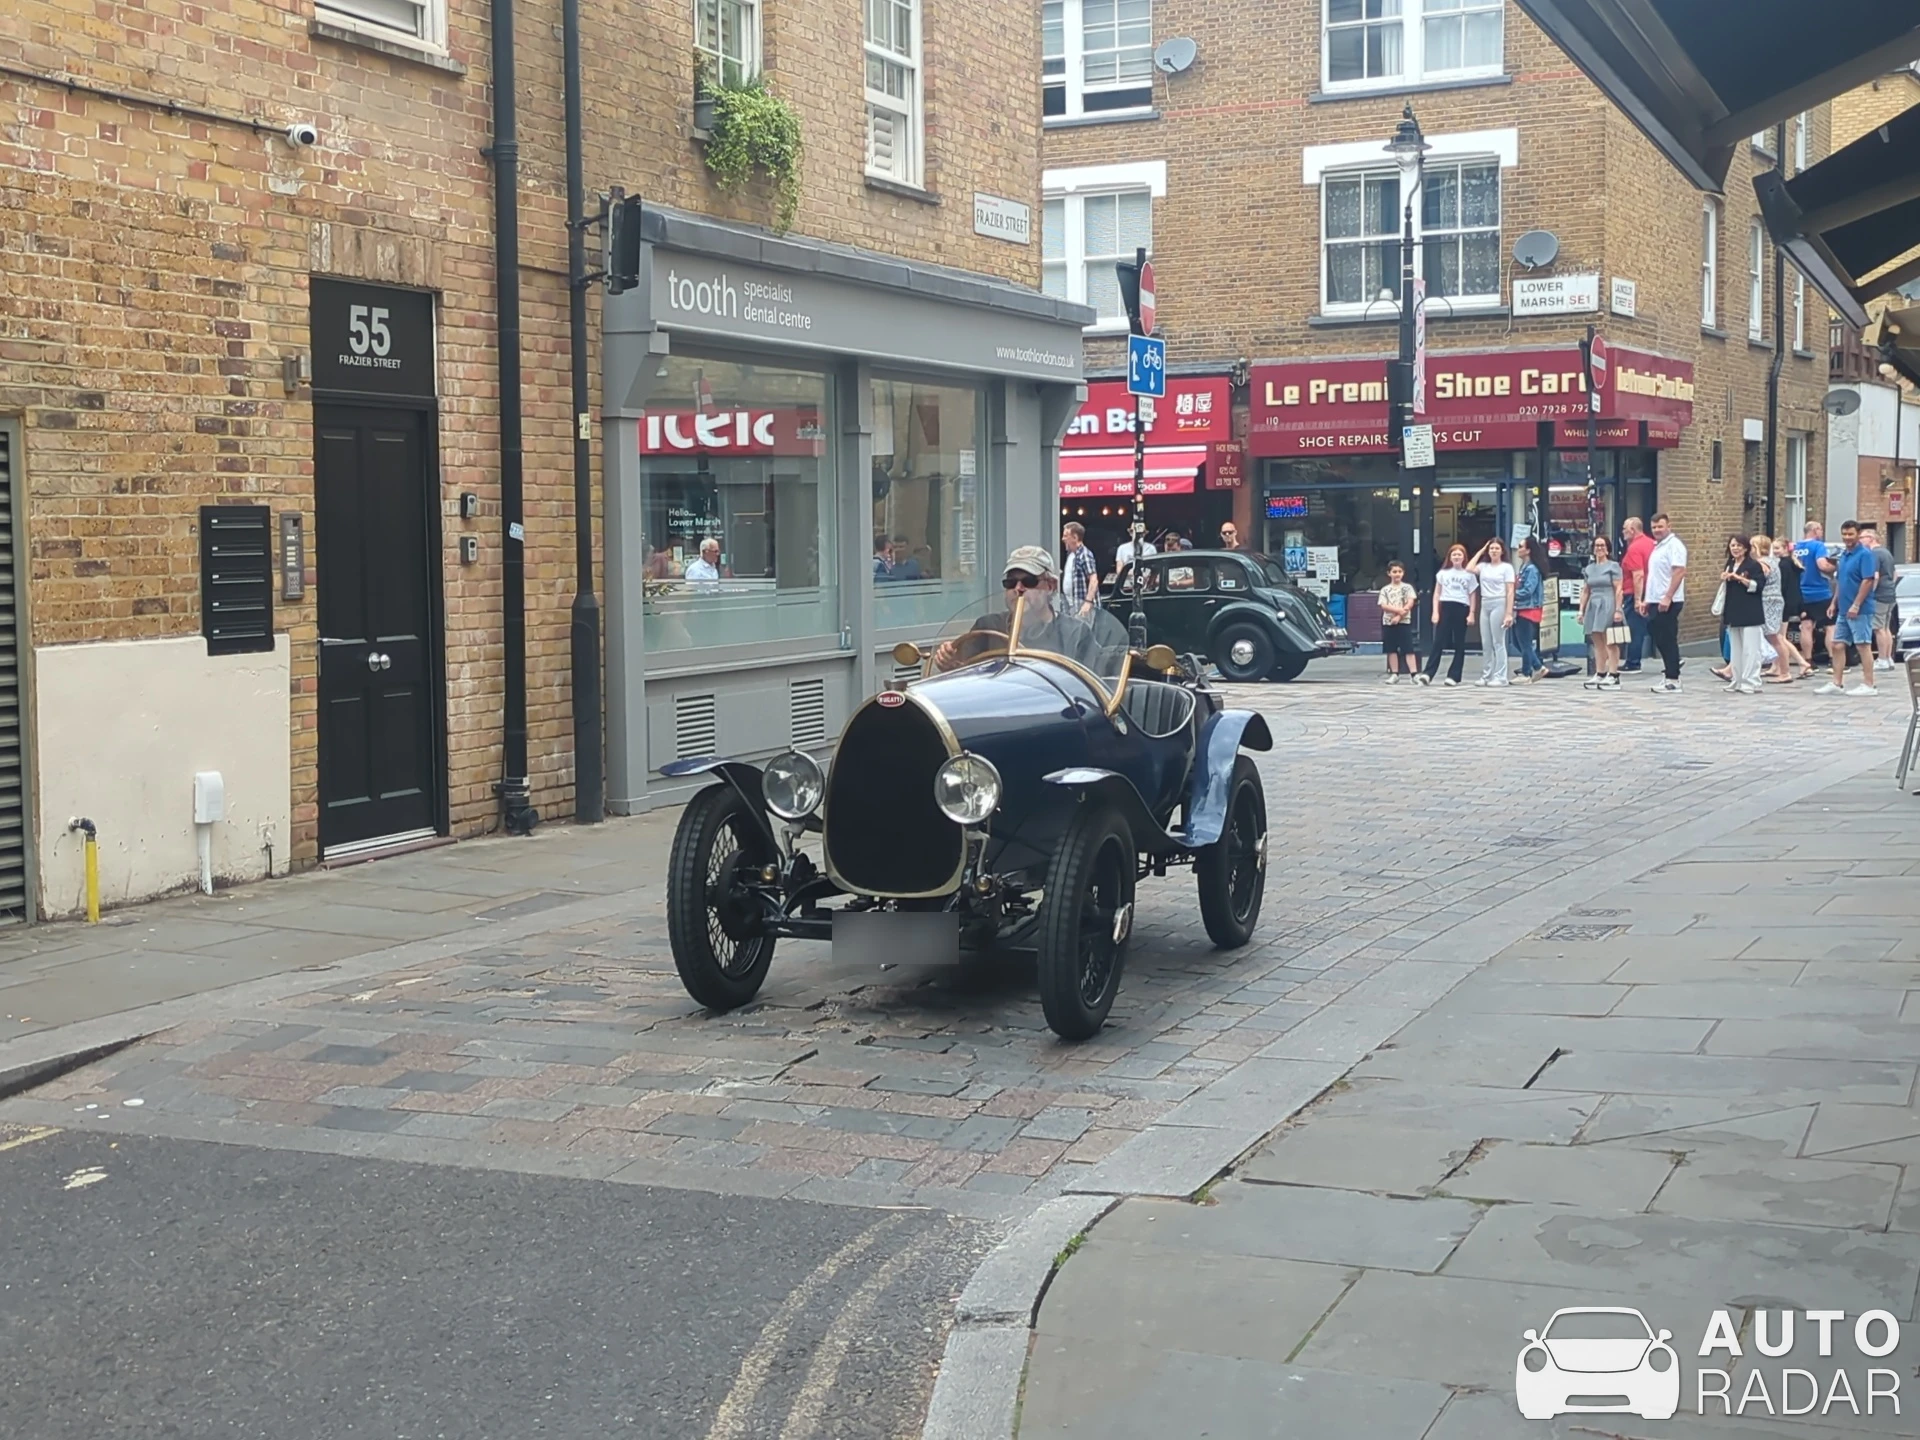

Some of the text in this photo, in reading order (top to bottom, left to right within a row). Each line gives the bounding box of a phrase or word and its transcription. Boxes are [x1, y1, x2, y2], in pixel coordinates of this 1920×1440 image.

[976, 208, 1028, 234] FRAZIER STREET
[668, 269, 737, 318] tooth
[743, 281, 793, 303] specialist
[1521, 282, 1563, 293] LOWER
[1521, 295, 1591, 308] MARSH SE1
[744, 302, 811, 330] dental centre
[349, 304, 391, 356] 55
[339, 354, 401, 369] FRAZIER STREET
[1265, 381, 1300, 406] Le
[1309, 376, 1389, 404] Premi
[1435, 372, 1511, 399] Shoe
[1519, 403, 1589, 415] 020 7928 792
[1266, 416, 1279, 425] 110
[1299, 430, 1482, 447] SHOE REPAIRS YS CUT
[1064, 484, 1089, 493] Bowl
[1113, 482, 1132, 492] Hot
[1143, 481, 1167, 491] oods
[668, 517, 721, 526] Lower Marsh
